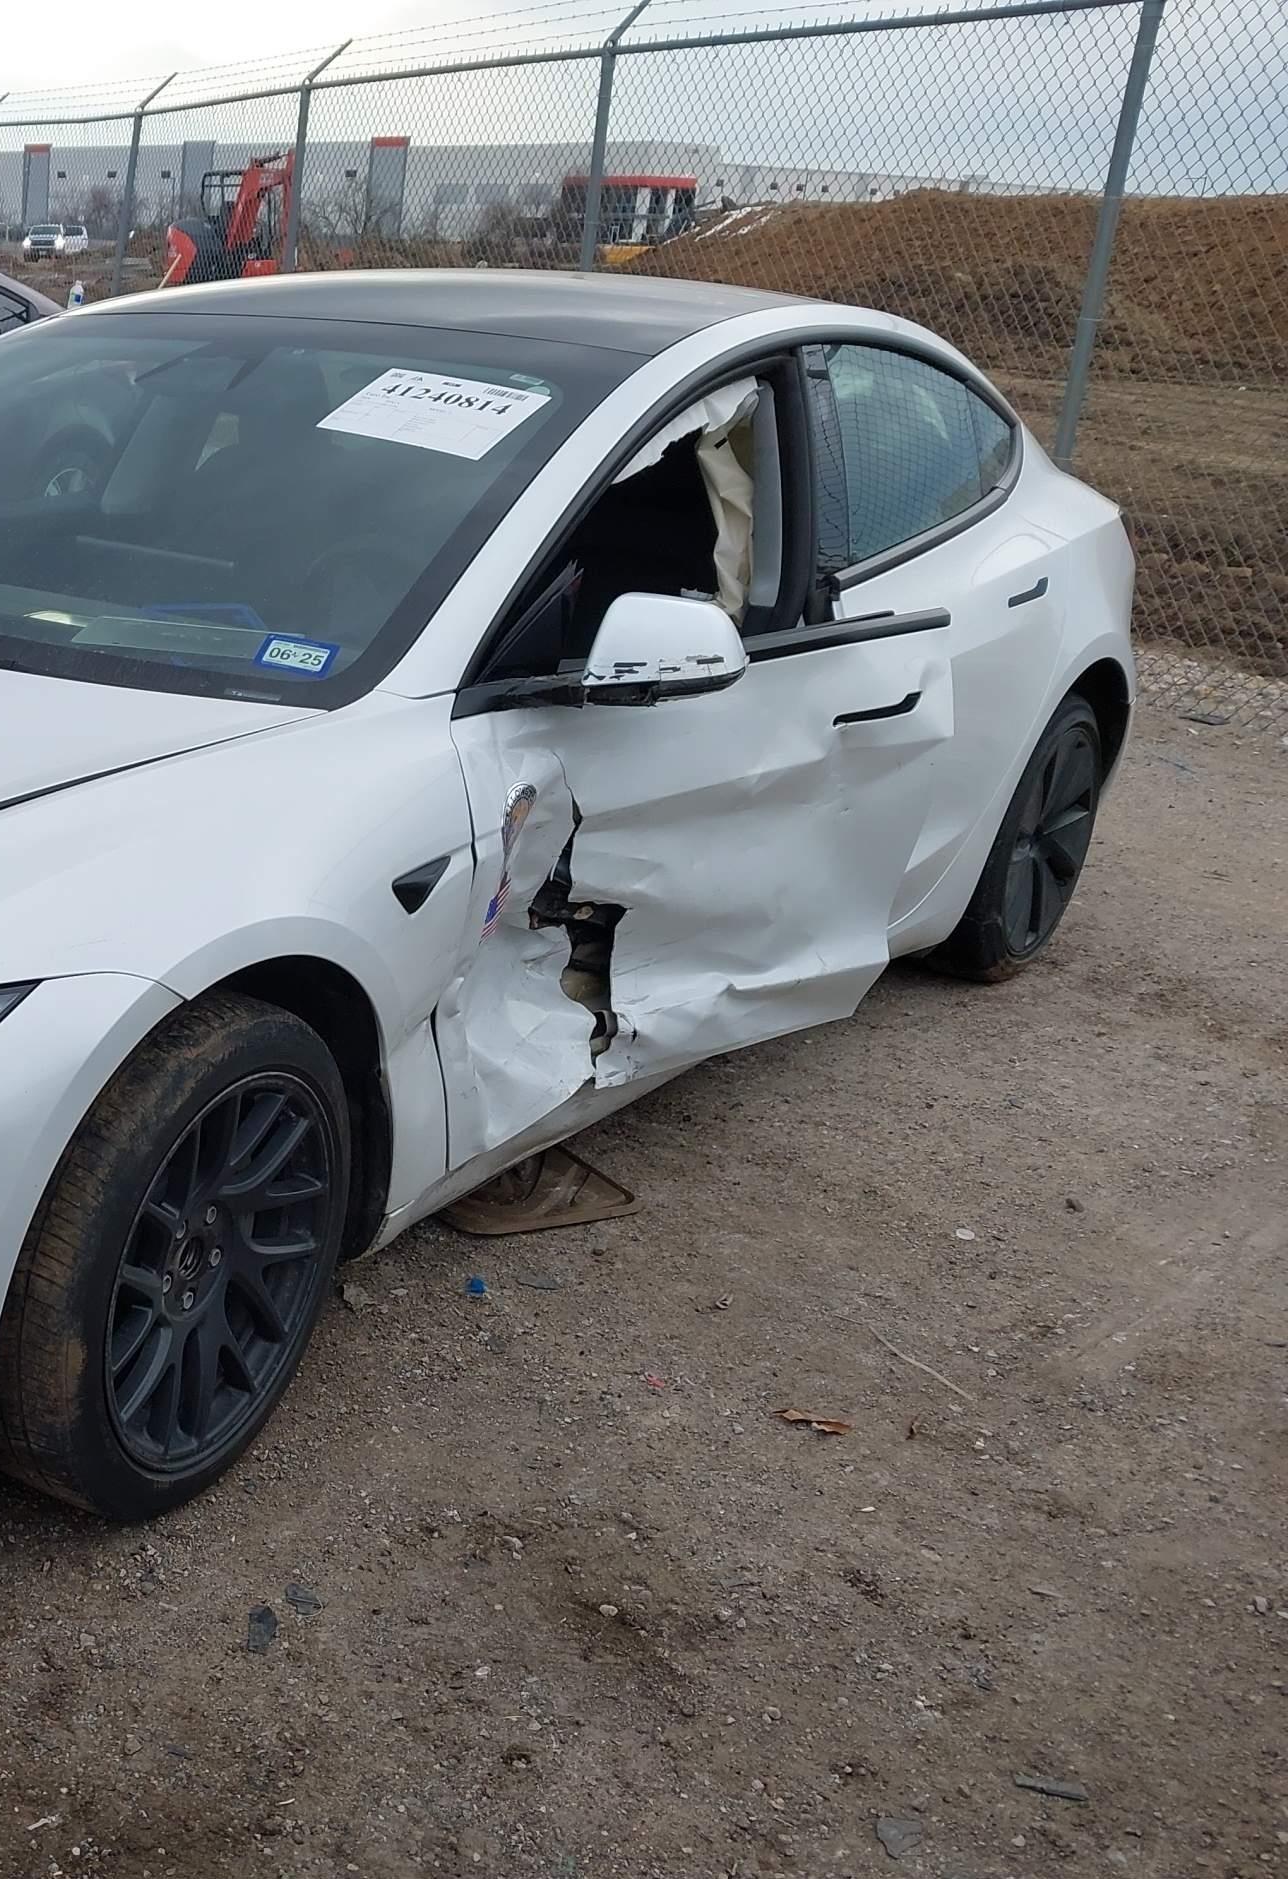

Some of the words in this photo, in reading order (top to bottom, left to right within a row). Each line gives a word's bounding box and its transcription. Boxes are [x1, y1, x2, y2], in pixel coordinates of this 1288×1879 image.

[381, 383, 514, 416] 41240814
[269, 647, 292, 661] 06
[299, 652, 325, 667] 25
